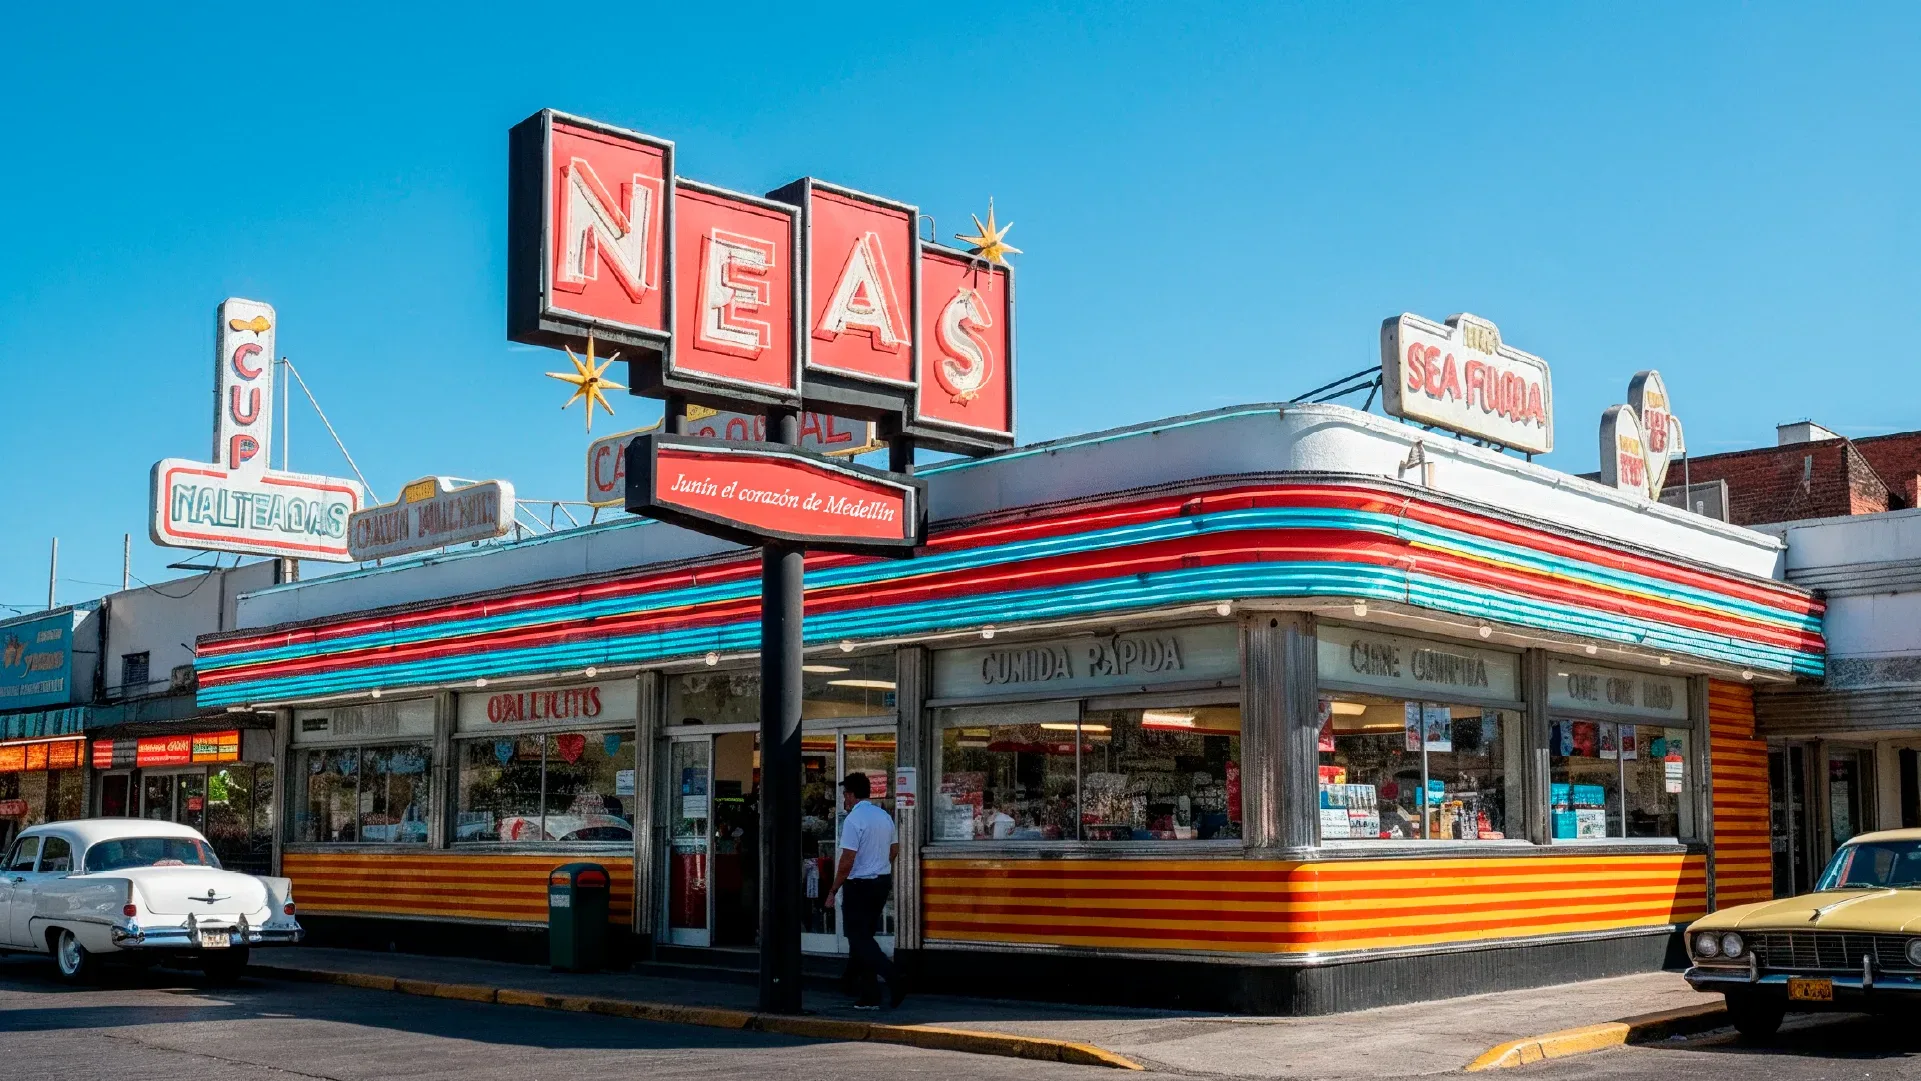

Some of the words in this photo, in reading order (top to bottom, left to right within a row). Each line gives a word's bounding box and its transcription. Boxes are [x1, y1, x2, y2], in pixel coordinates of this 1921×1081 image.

[554, 157, 993, 406] NEAS
[230, 343, 263, 470] CUP
[1407, 342, 1462, 402] SEA
[671, 473, 717, 497] Junín
[721, 480, 738, 499] el
[738, 488, 800, 508] corazón
[803, 492, 822, 511] de
[823, 495, 895, 522] Medellín
